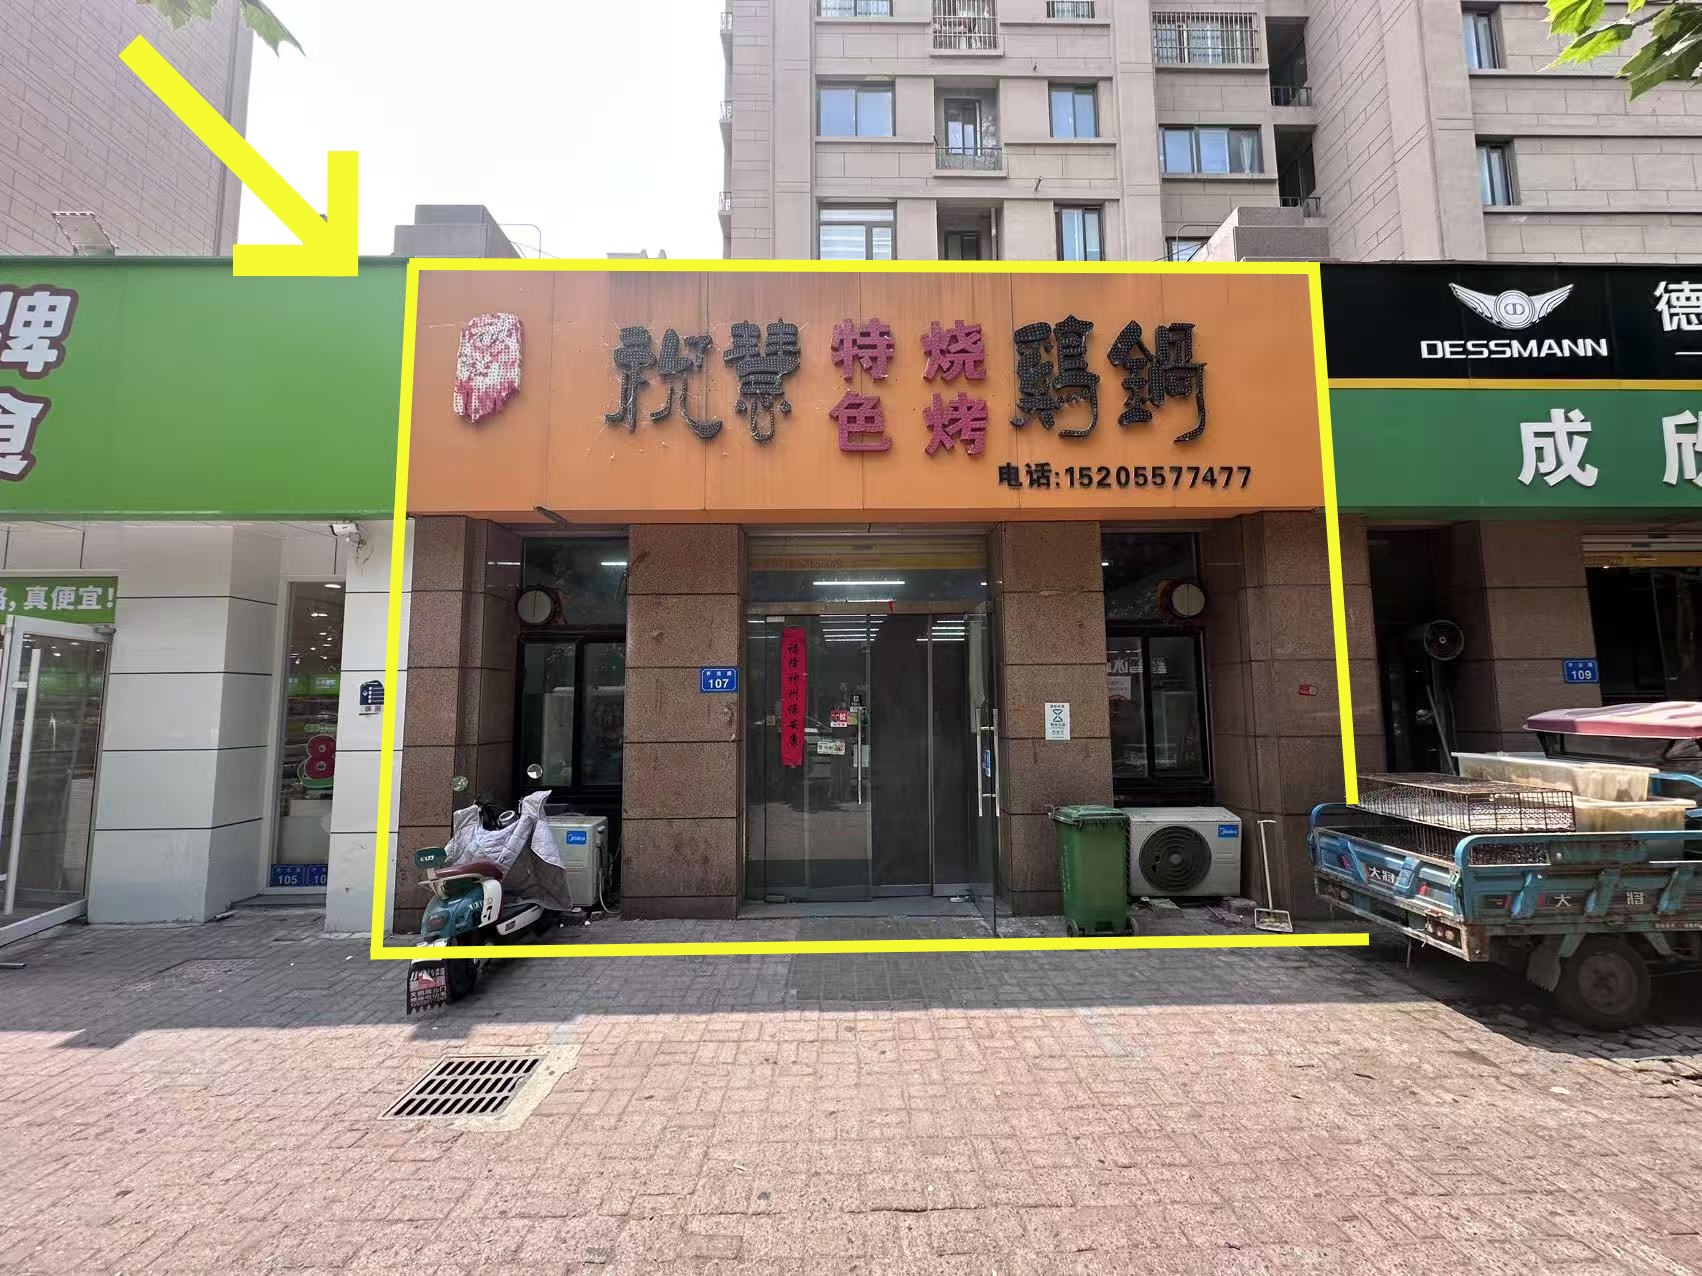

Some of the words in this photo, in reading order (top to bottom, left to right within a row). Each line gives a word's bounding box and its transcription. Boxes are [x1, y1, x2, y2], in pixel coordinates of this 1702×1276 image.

[1653, 280, 1702, 331] 德
[1420, 338, 1608, 359] DESSMANN
[830, 317, 895, 456] 特色
[920, 319, 988, 456] 烧烤
[998, 462, 1252, 489] 电话:15205577477
[708, 678, 730, 689] 107
[1571, 670, 1592, 680] 109
[278, 874, 298, 885] 105
